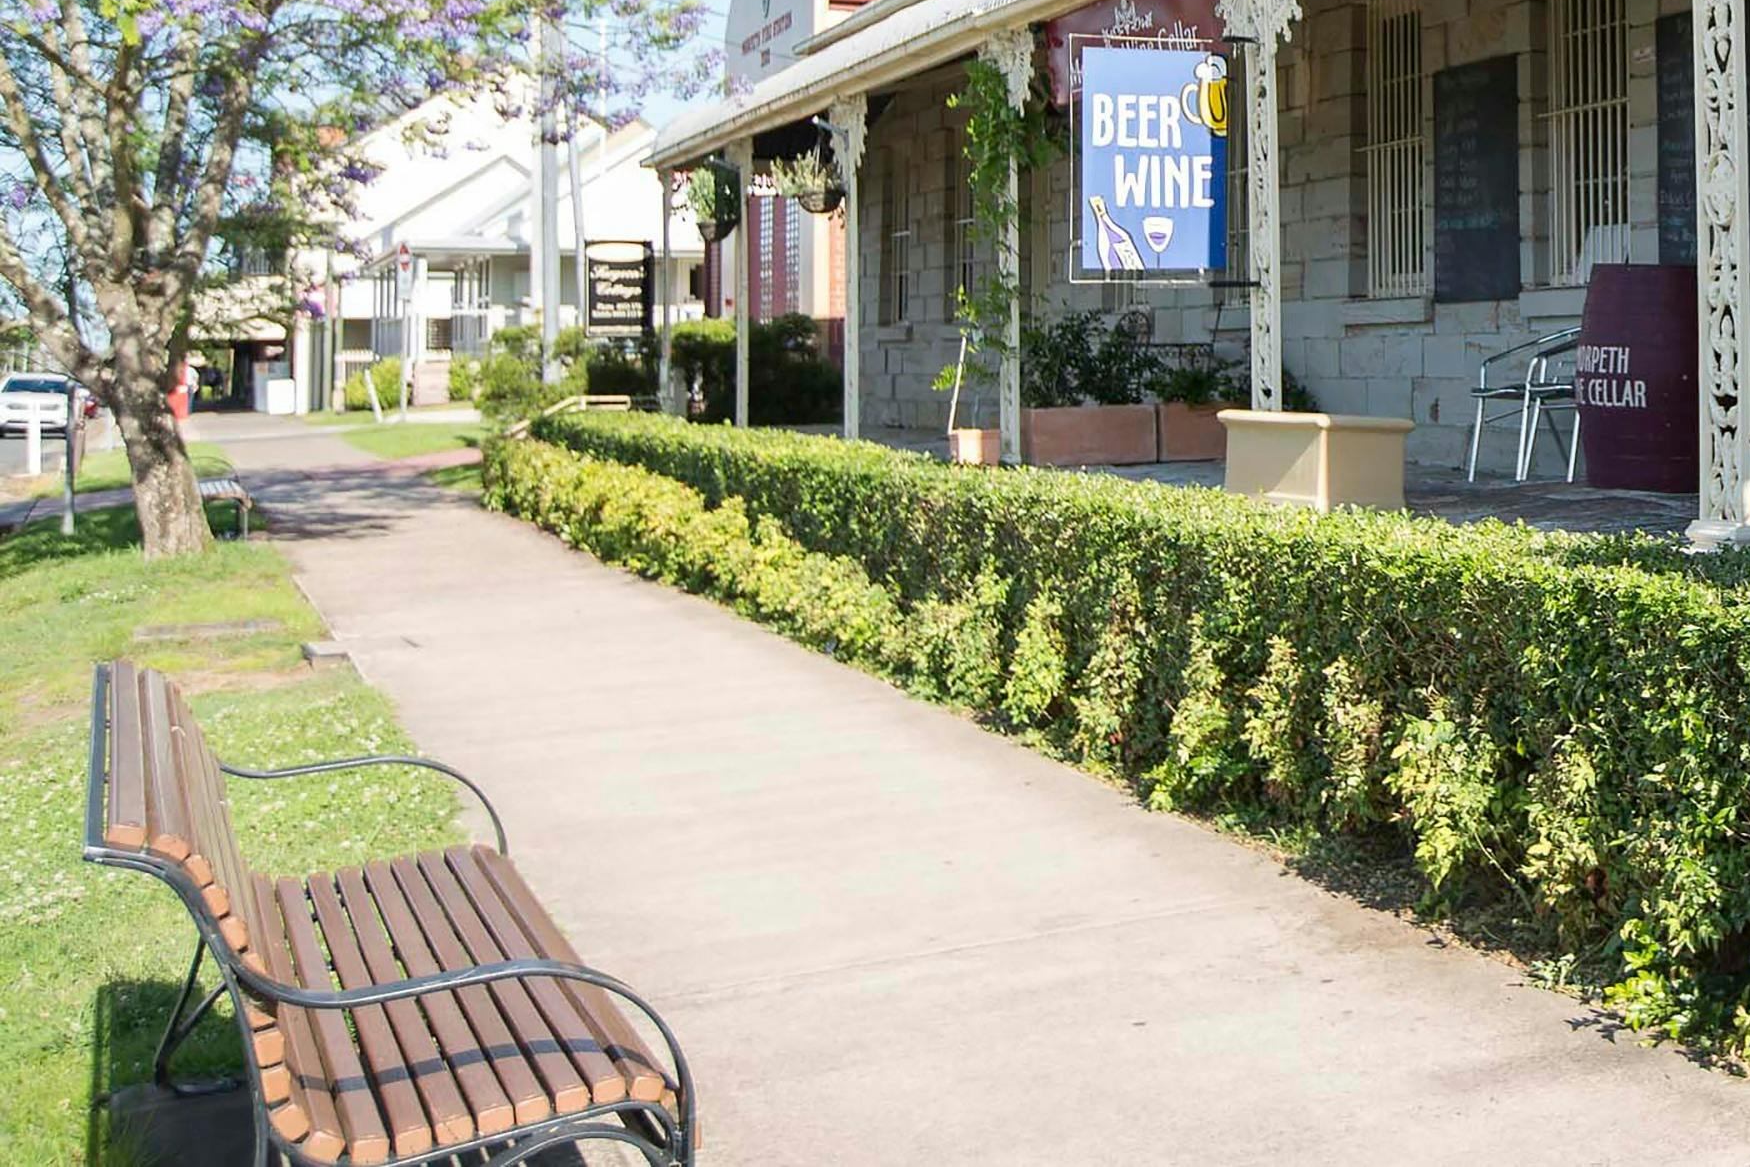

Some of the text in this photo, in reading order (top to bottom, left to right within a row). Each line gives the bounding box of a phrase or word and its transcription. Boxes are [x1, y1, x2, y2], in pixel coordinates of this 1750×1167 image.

[1091, 92, 1183, 149] BEER
[1113, 153, 1216, 209] WINE
[1576, 344, 1631, 374] ORPETH
[1587, 378, 1648, 408] CELLAR
